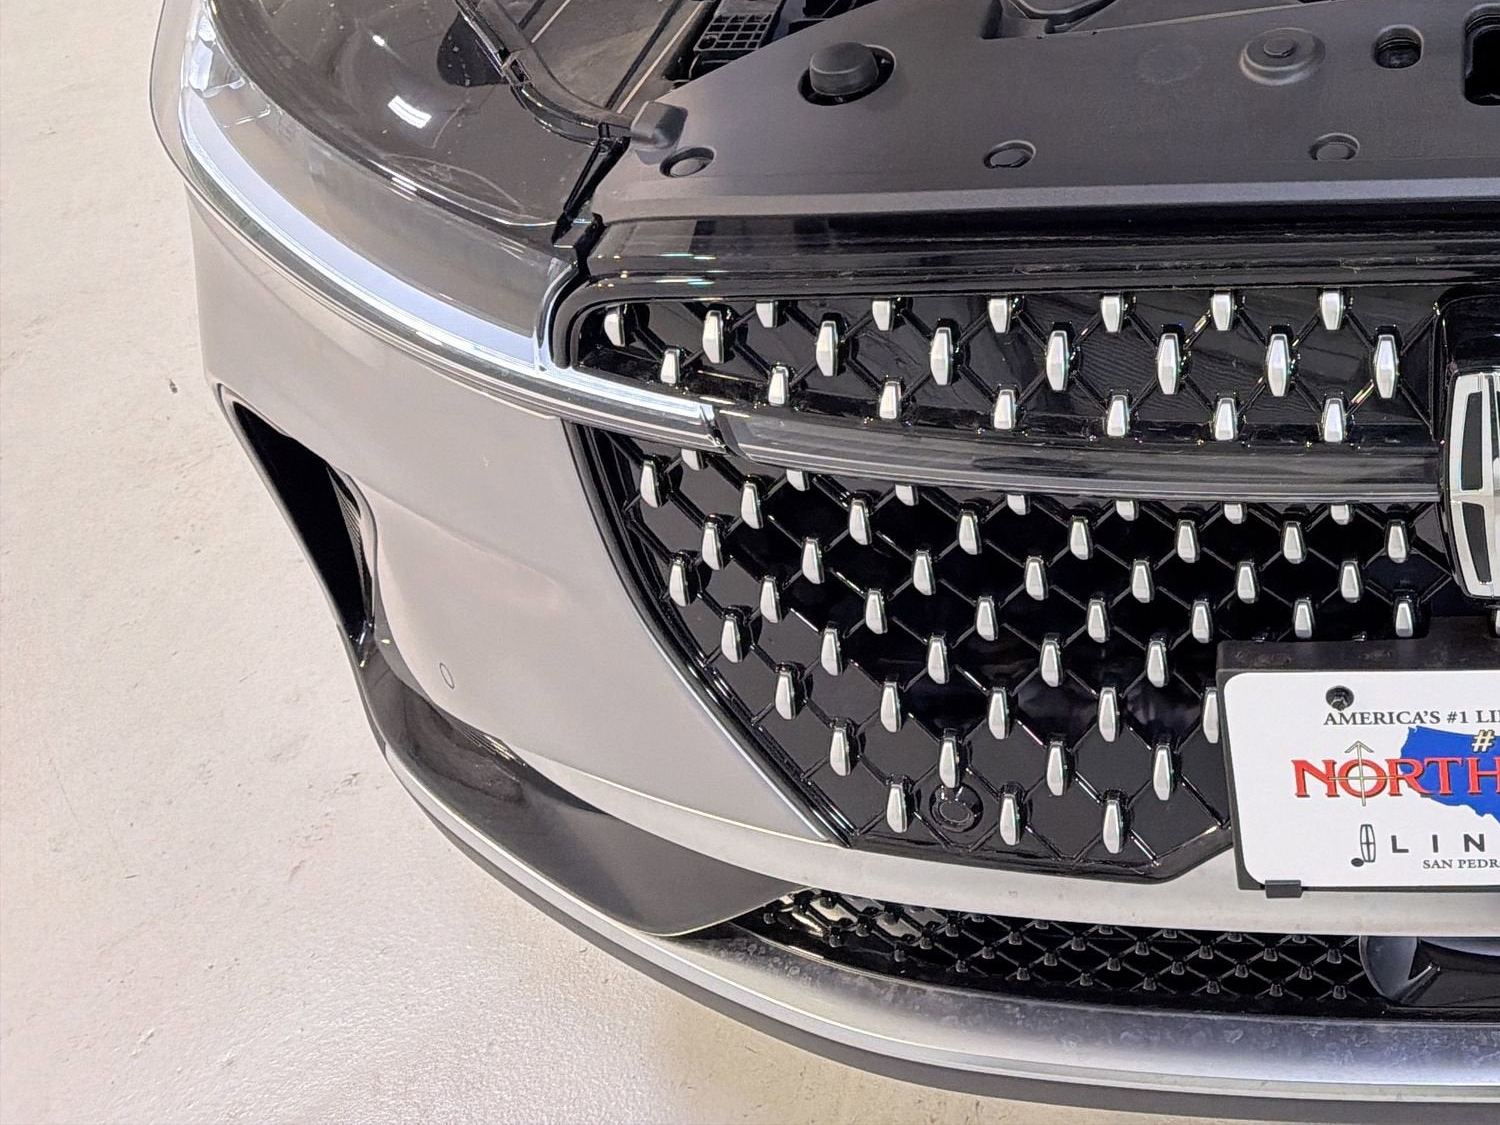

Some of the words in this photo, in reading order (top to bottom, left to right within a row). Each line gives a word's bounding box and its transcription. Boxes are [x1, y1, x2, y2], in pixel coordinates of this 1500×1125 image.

[1323, 709, 1441, 726] AMERICA'S
[1447, 710, 1469, 724] #1
[1422, 859, 1453, 870] SAN
